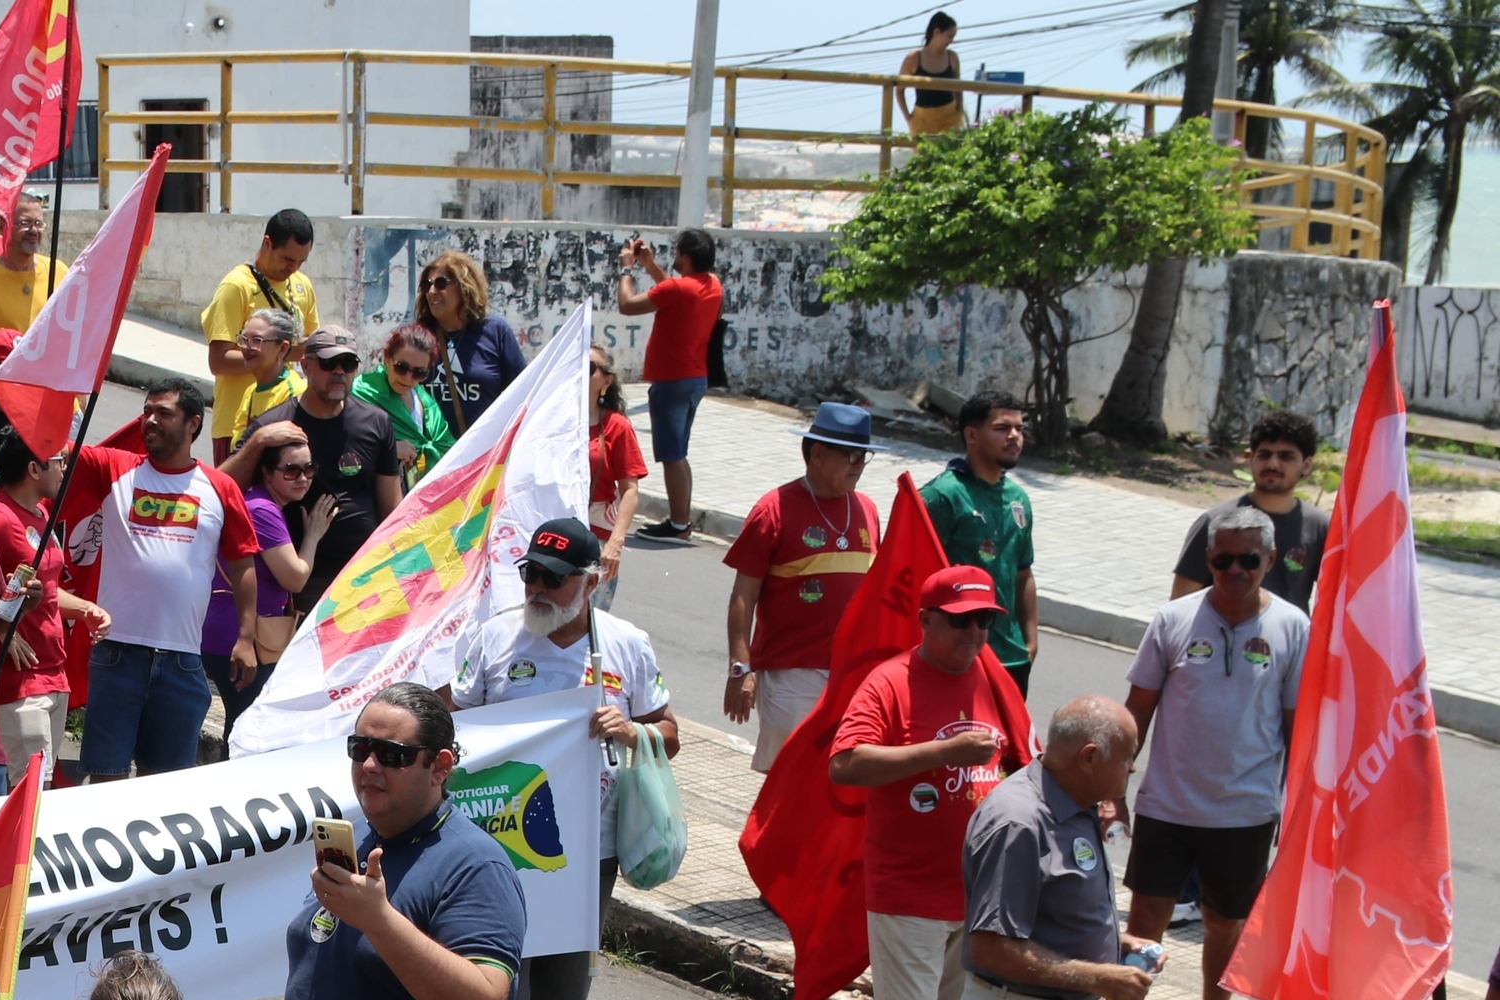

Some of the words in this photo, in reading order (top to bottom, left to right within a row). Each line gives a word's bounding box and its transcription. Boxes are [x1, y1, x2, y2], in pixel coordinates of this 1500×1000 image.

[134, 495, 197, 524] CTB
[537, 532, 570, 551] CTB
[945, 764, 1000, 793] Natal
[460, 796, 506, 820] ANIA
[510, 793, 523, 813] E
